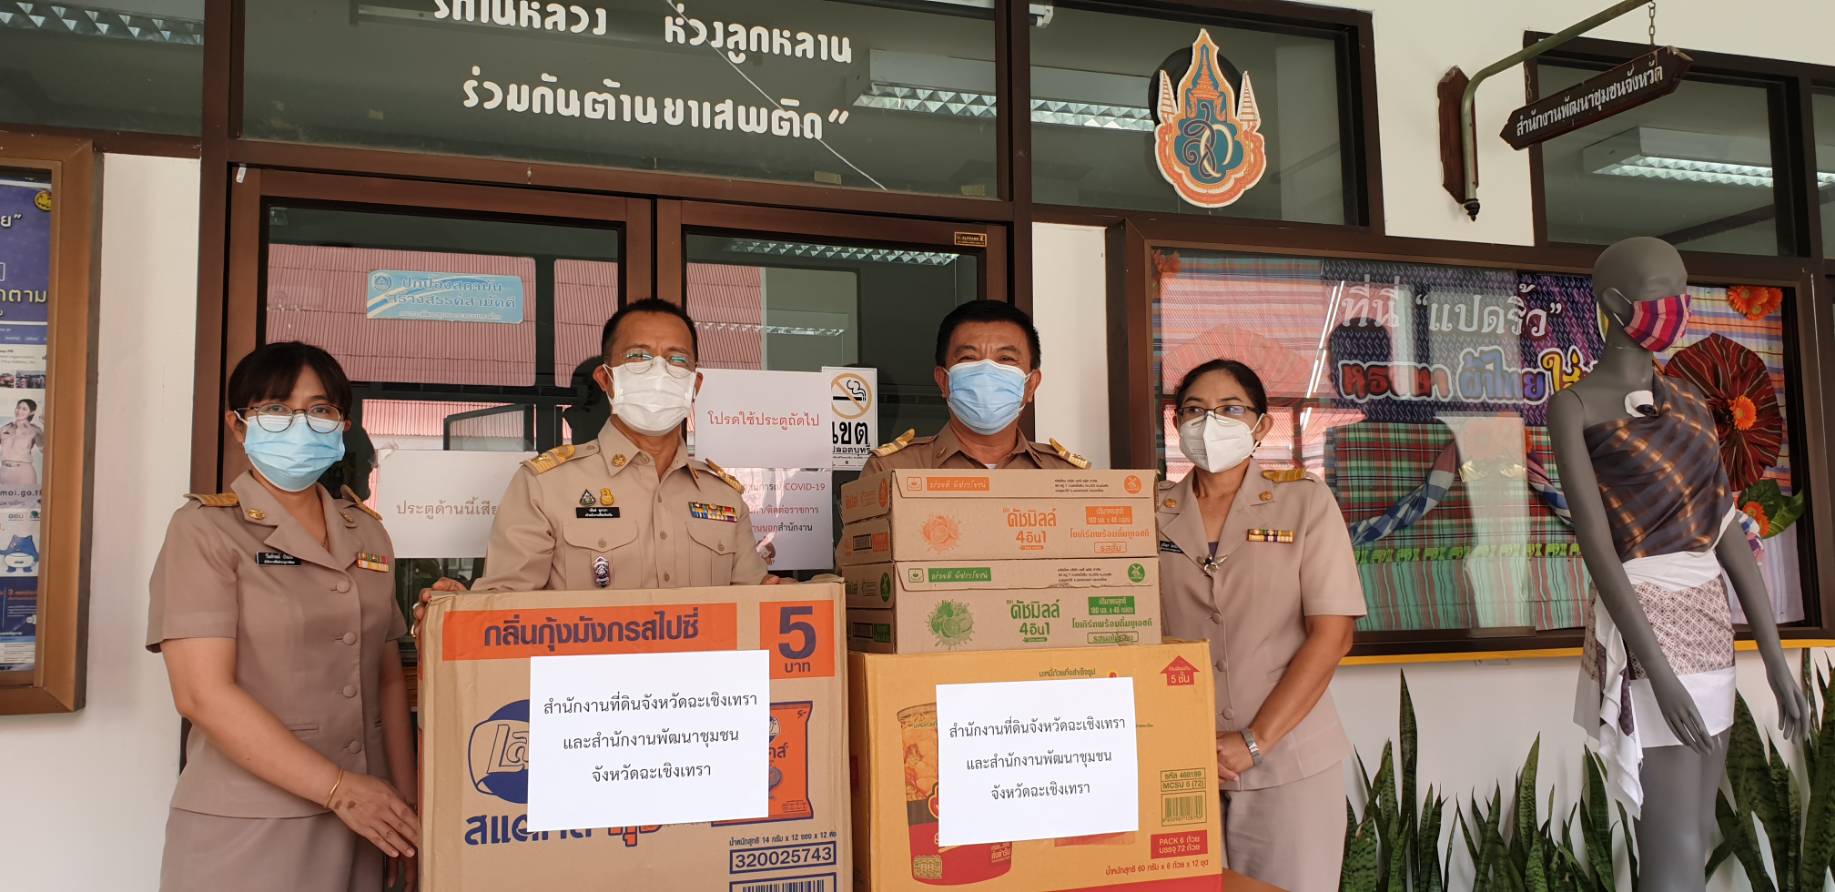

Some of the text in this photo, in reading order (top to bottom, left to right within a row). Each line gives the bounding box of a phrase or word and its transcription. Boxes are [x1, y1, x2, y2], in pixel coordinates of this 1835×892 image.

[664, 4, 852, 64] ห่วงลูกหลาน
[1515, 59, 1664, 137] สำนักงานพัฒนาชุมชนจังหวัด
[1340, 361, 1451, 402] หรษา
[707, 409, 820, 431] โปรดใช้ประตูถัดไป
[784, 482, 826, 492] COVID-19
[1007, 507, 1057, 528] ดัชมิลล์
[1010, 599, 1060, 619] ดัชมิลล์
[484, 606, 700, 653] กลิ่นกุ้งมังกรสไปซี่
[777, 605, 818, 660] 5
[783, 660, 812, 675] บาท
[1170, 674, 1177, 684] 5
[543, 690, 758, 715] สำนักงานที่ดินจังหวัดฉะเชิงเทรา
[949, 715, 1126, 739] สำนักงานที่ดินจังหวัดฉะเชิงเทรา
[562, 727, 740, 751] และสำนักงานพัฒนาชุมชน
[966, 749, 1112, 771] และสำนักงานพัฒนาชุมชน
[591, 763, 712, 783] จังหวัดฉะเชิงเทรา
[991, 781, 1091, 801] จังหวัดฉะเชิงเทรา
[1159, 837, 1178, 846] PACK
[735, 846, 832, 868] 320025743
